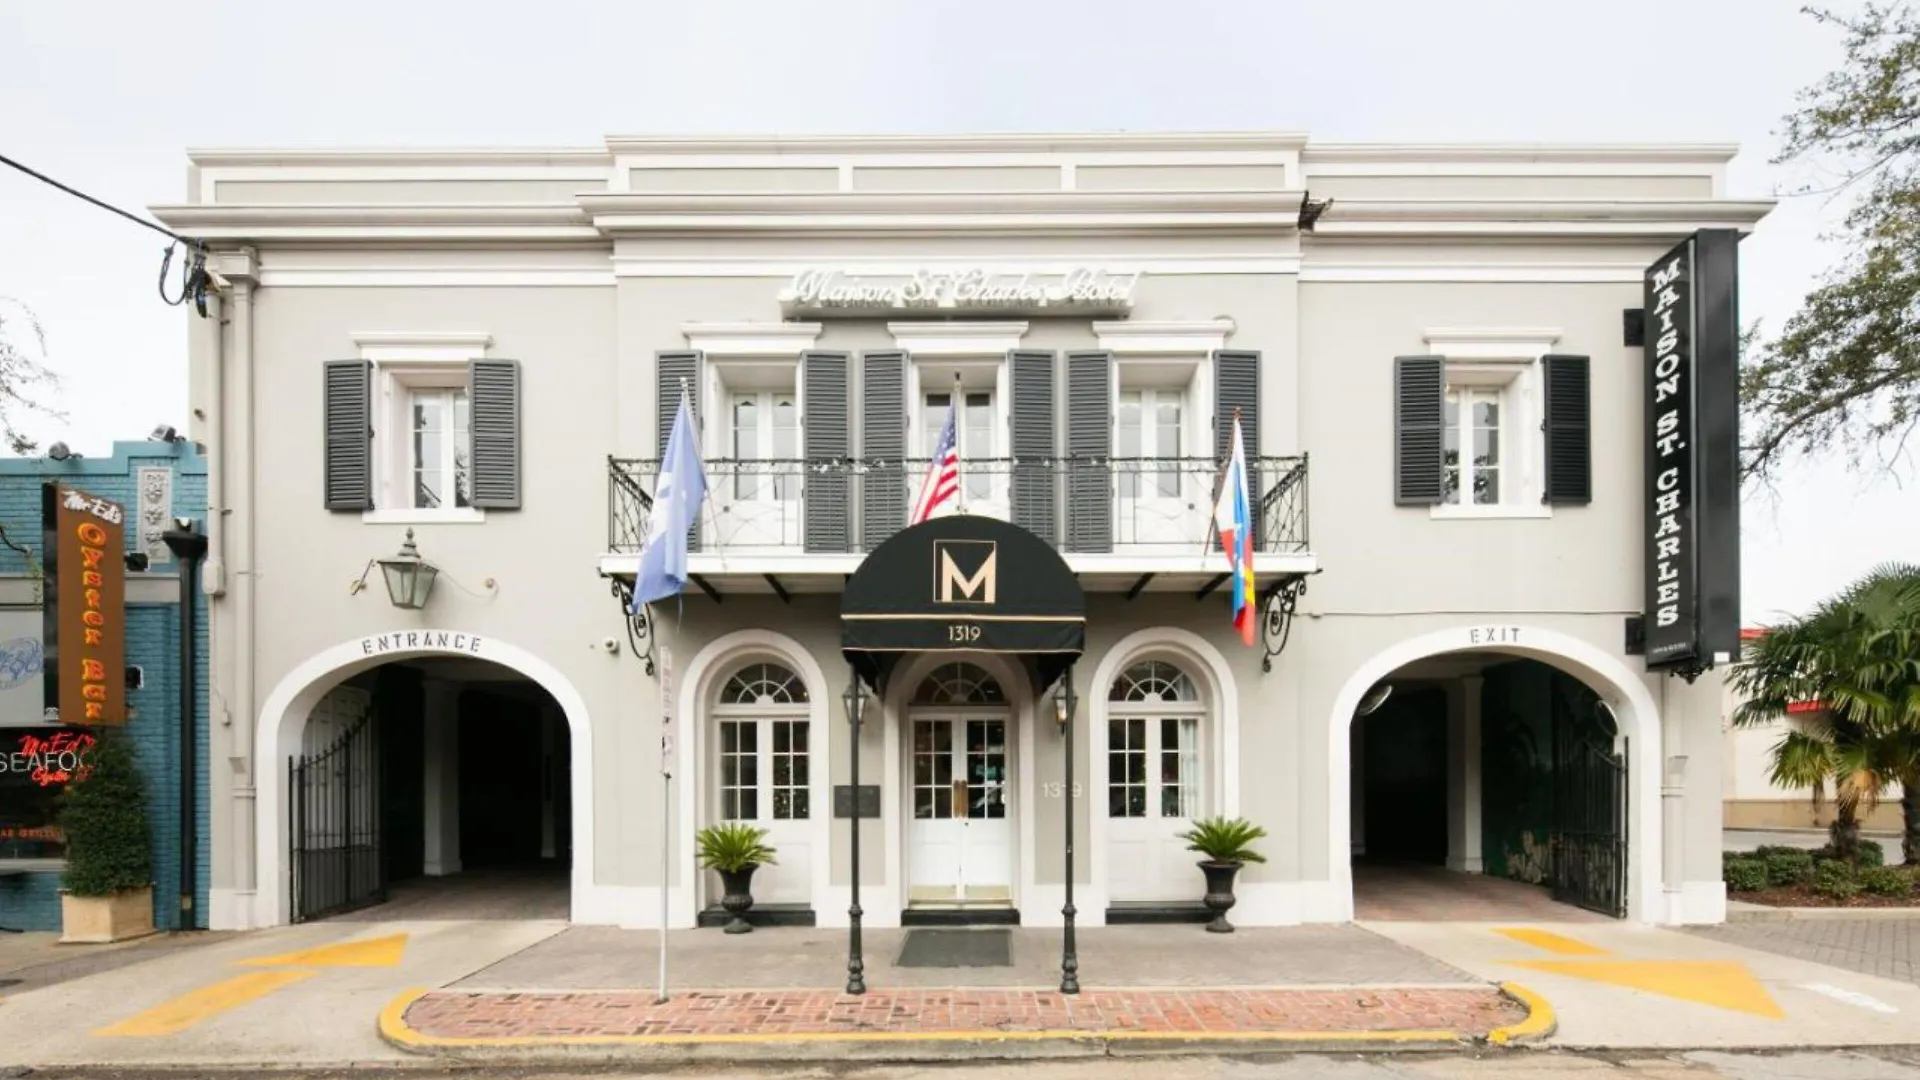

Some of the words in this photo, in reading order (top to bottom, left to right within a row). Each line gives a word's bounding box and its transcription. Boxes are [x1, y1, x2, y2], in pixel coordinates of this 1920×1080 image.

[1653, 257, 1680, 403] MAISON
[1656, 409, 1685, 457] ST.
[1655, 467, 1681, 627] CHARLES
[942, 548, 996, 603] M
[361, 631, 482, 655] ENTRANCE
[948, 625, 981, 641] 1319
[1470, 627, 1520, 644] EXIT
[1040, 781, 1083, 798] 139
